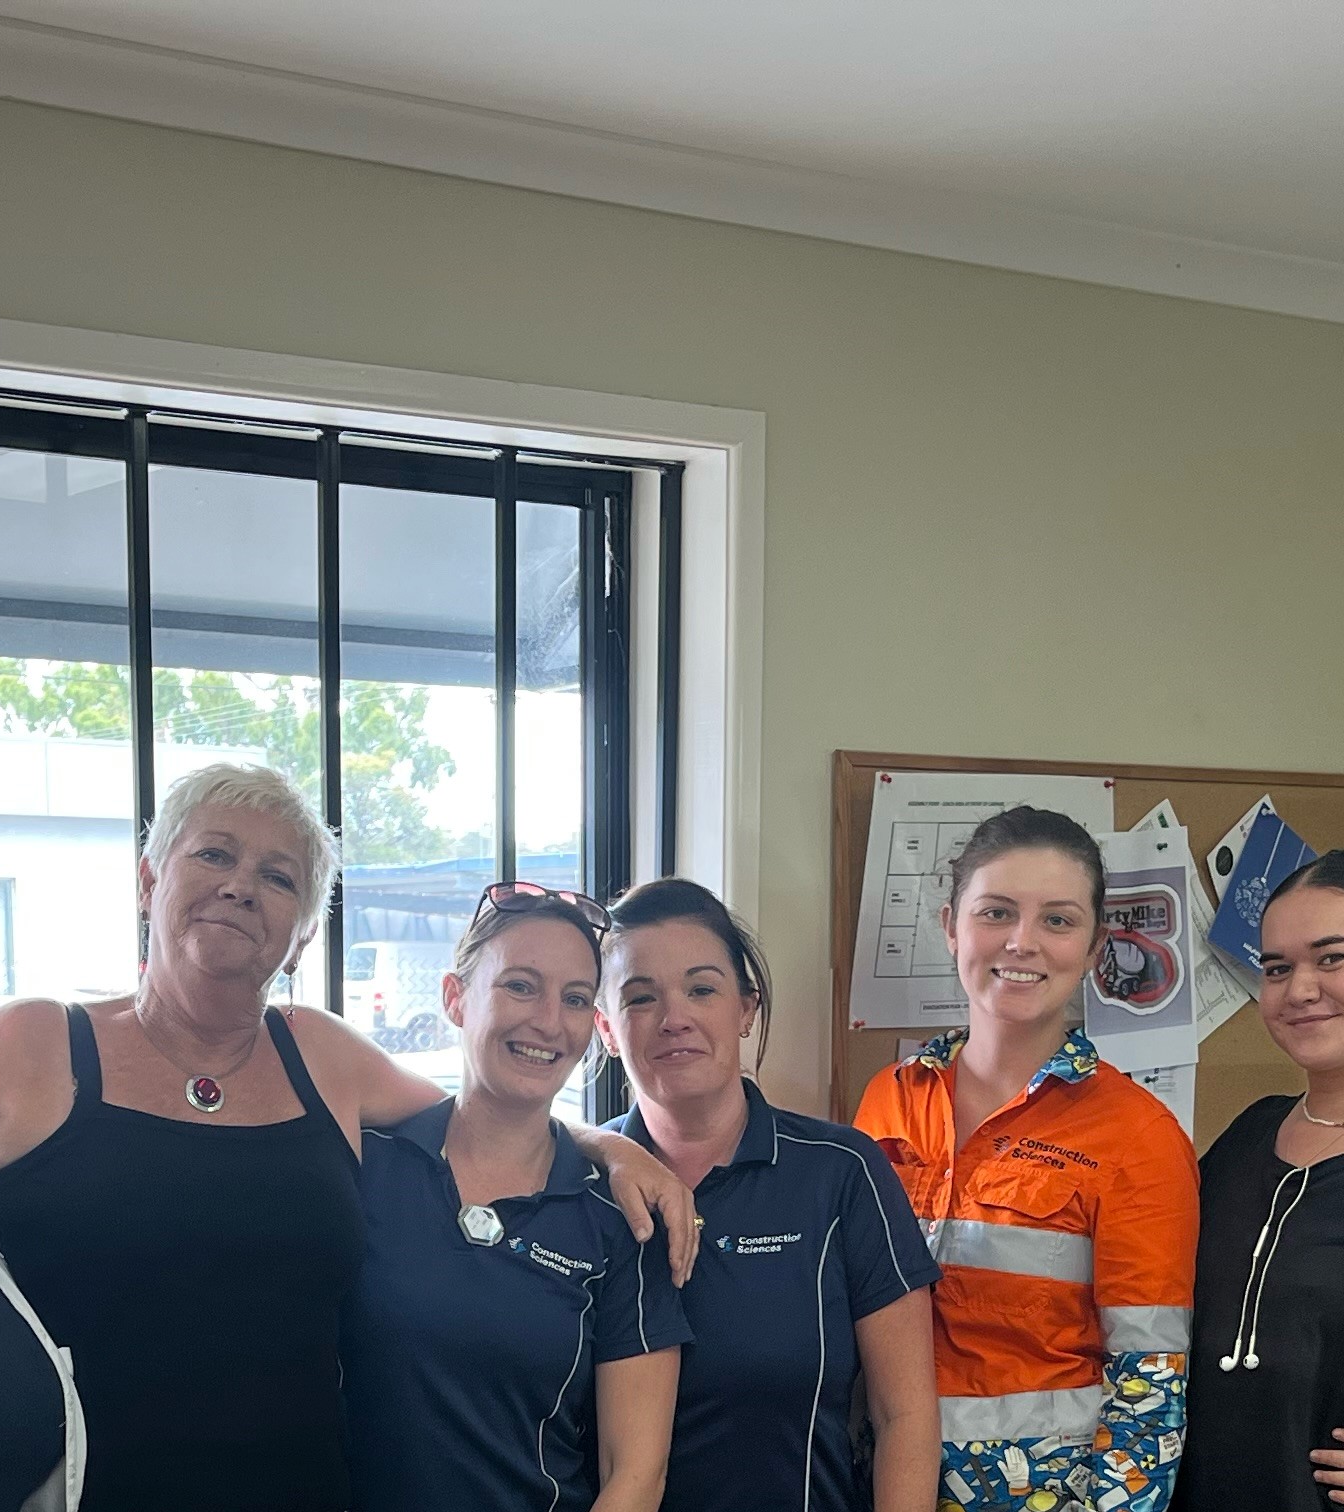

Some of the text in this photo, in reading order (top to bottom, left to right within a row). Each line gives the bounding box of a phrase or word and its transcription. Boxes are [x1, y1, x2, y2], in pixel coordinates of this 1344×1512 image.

[1011, 1147, 1066, 1170] Sciences
[1018, 1137, 1099, 1169] Construction
[531, 1241, 593, 1272] Construction
[736, 1244, 782, 1254] Sciences
[529, 1250, 571, 1276] Sciences
